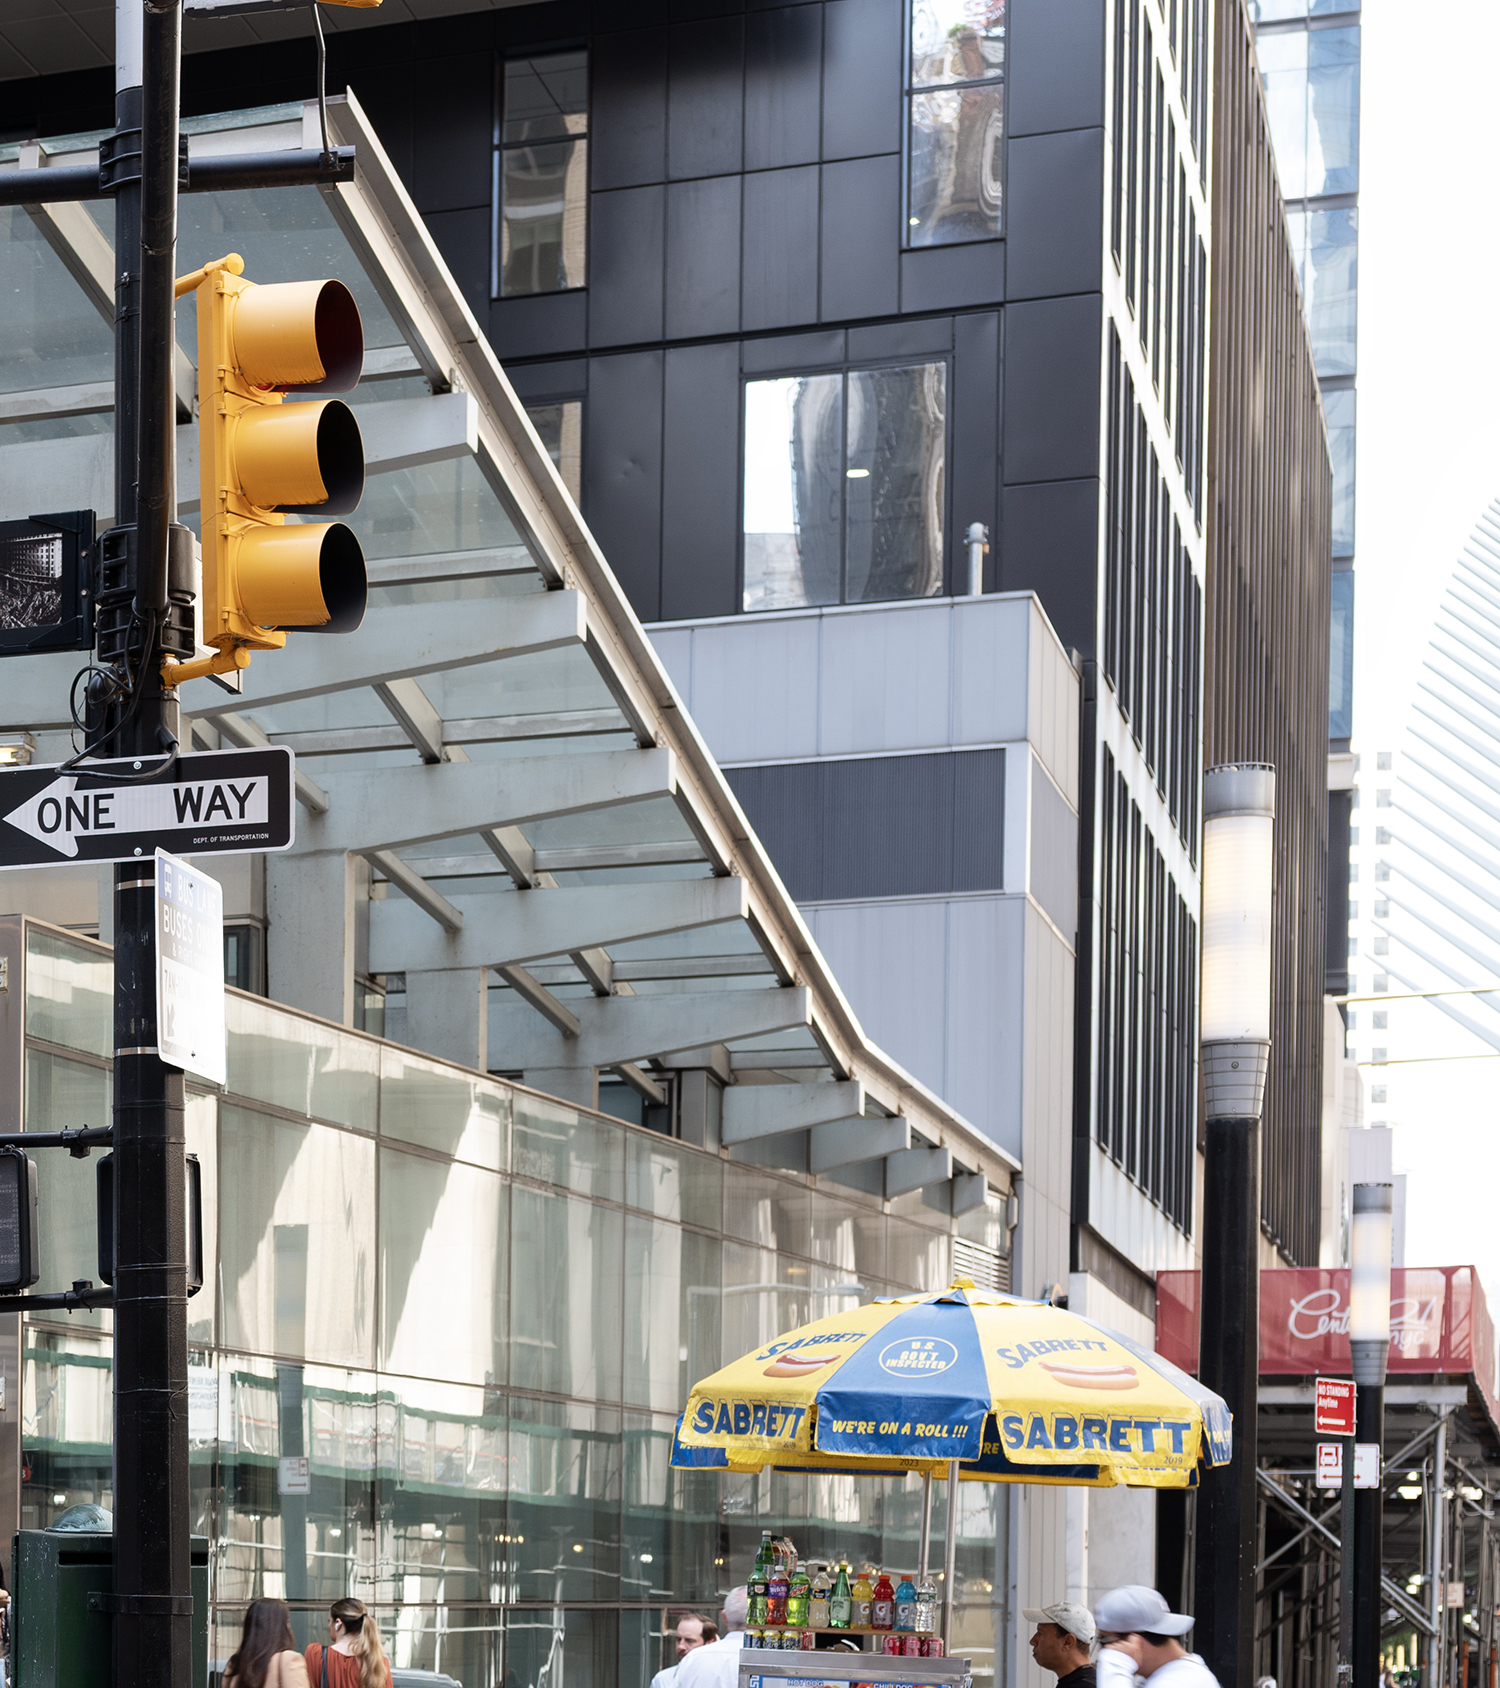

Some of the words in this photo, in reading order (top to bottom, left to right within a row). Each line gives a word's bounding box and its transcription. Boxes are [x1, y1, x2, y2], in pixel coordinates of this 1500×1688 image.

[37, 793, 116, 834] ONE
[173, 782, 257, 823] WAY
[219, 833, 269, 842] TRANSPORTATION
[178, 874, 194, 908] BUS
[197, 883, 217, 920] LANE
[163, 904, 193, 944] BUSES
[755, 1332, 869, 1361] SABRETT
[997, 1339, 1109, 1369] SABRETT
[885, 1359, 947, 1370] INSPECTED
[1318, 1384, 1326, 1395] NO
[1326, 1386, 1349, 1399] STANDING
[1318, 1397, 1338, 1410] Anytime
[692, 1397, 807, 1439] SABRETT
[832, 1420, 876, 1434] WE'RE
[879, 1421, 899, 1435] ON
[901, 1422, 911, 1435] A
[914, 1423, 949, 1438] ROLL
[952, 1425, 969, 1438] !!!
[1001, 1411, 1191, 1454] SABRETT
[899, 1458, 920, 1467] 2023
[1164, 1456, 1183, 1465] 2019
[787, 1679, 804, 1687] HOT
